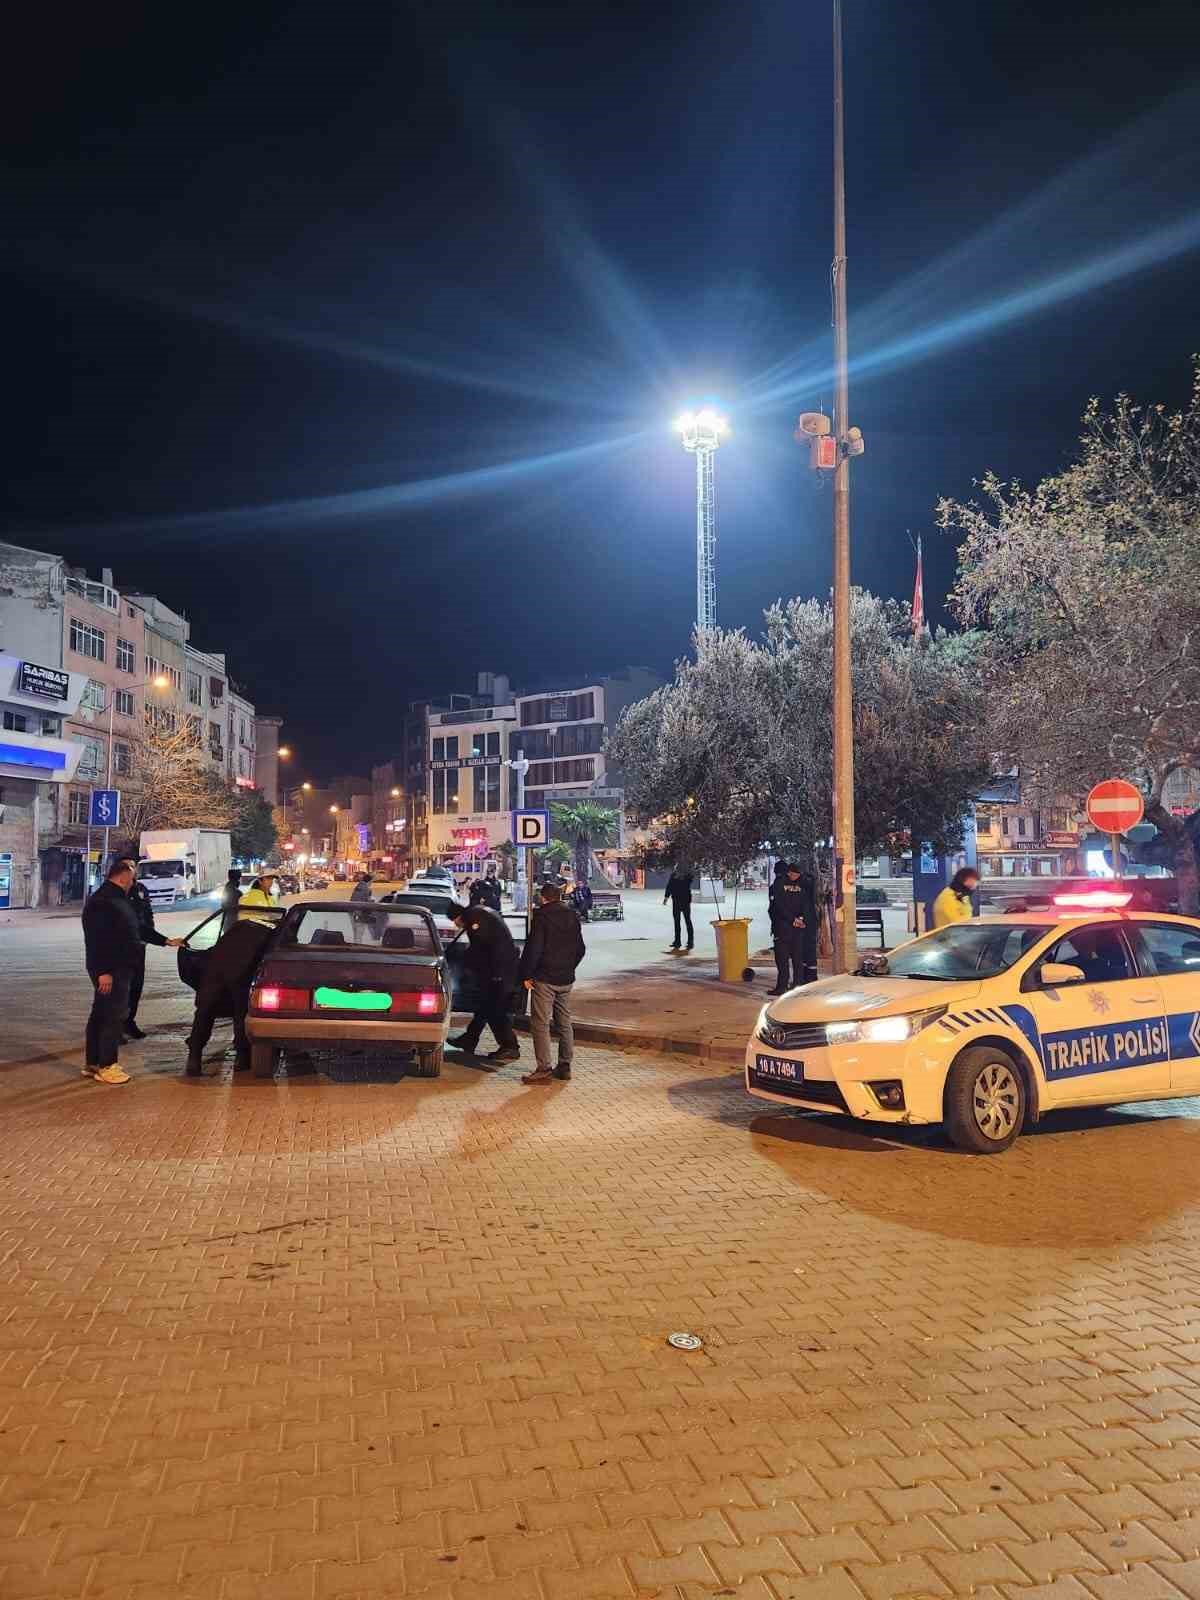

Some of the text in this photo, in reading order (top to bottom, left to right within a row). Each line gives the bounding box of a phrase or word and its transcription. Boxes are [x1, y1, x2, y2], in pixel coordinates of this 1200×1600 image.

[522, 817, 541, 839] D
[1047, 1021, 1167, 1070] TRAFİK POLİSİ
[770, 1060, 775, 1075] A
